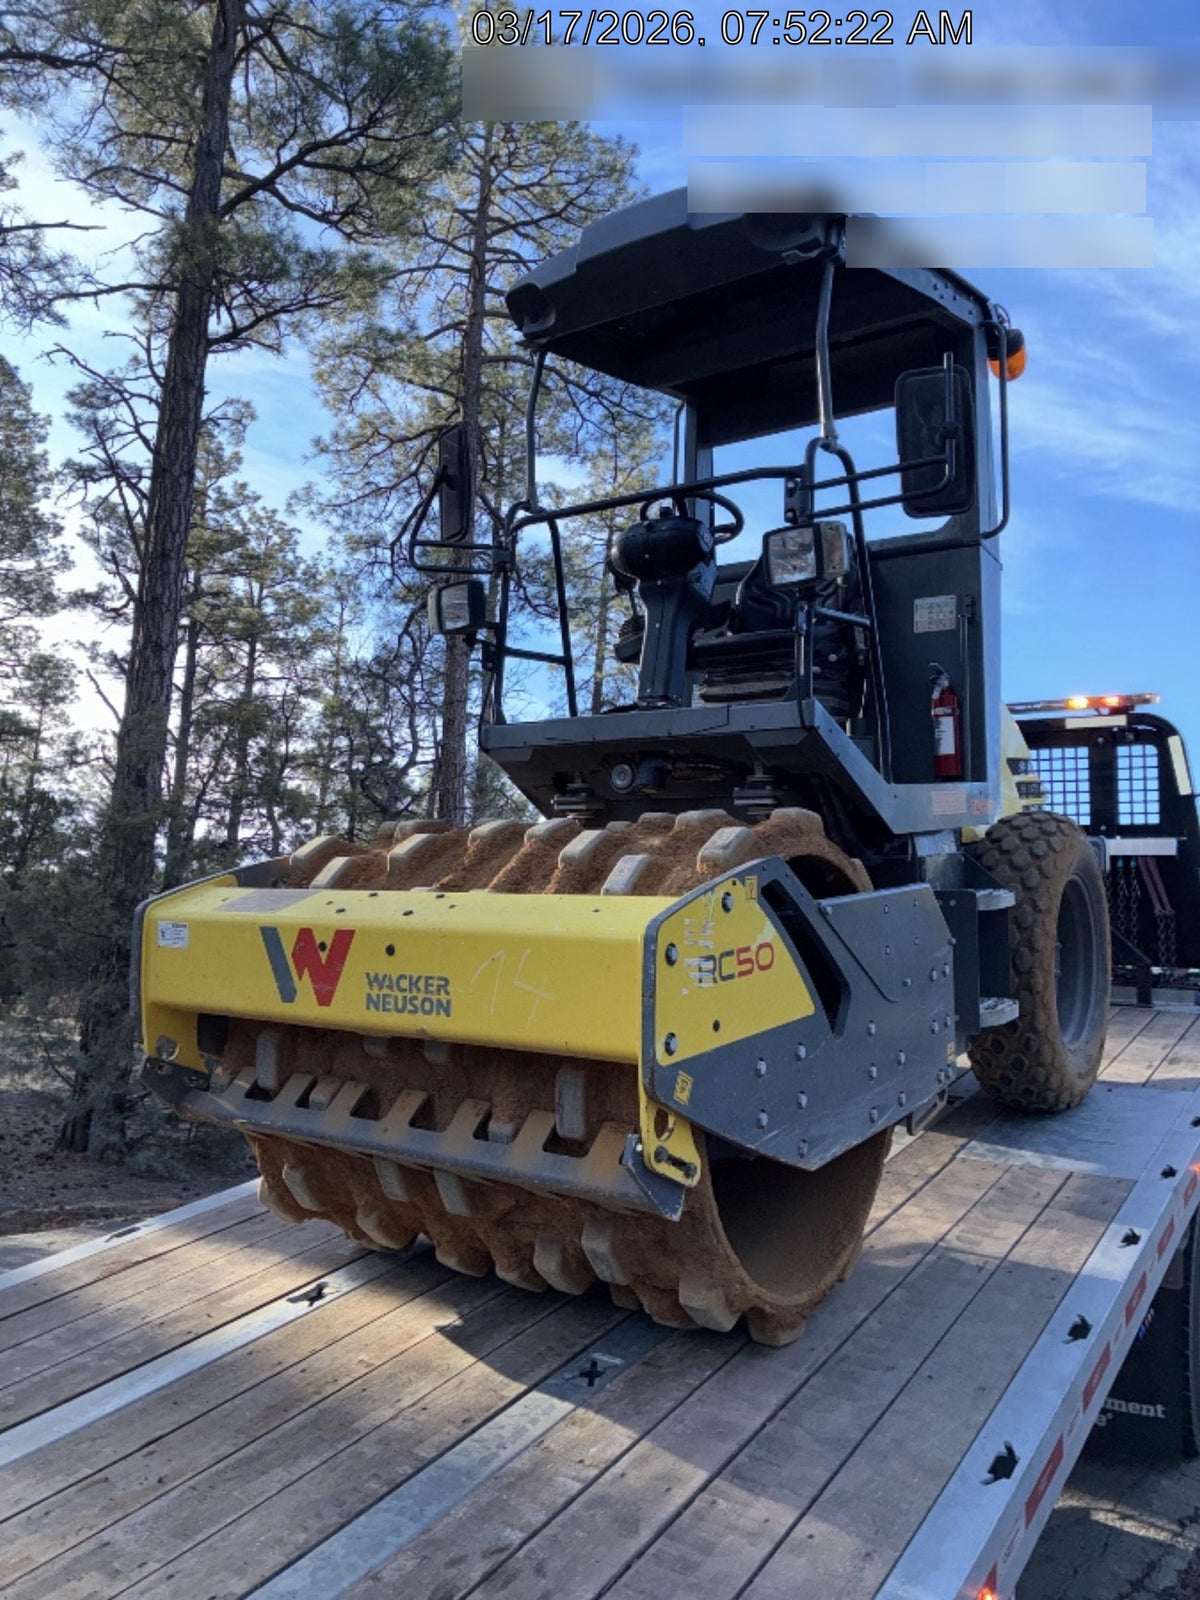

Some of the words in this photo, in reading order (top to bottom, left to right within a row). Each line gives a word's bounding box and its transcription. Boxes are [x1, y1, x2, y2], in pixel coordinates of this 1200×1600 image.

[698, 941, 775, 984] RC50
[365, 972, 451, 996] WACKER
[366, 992, 452, 1018] NEUSON
